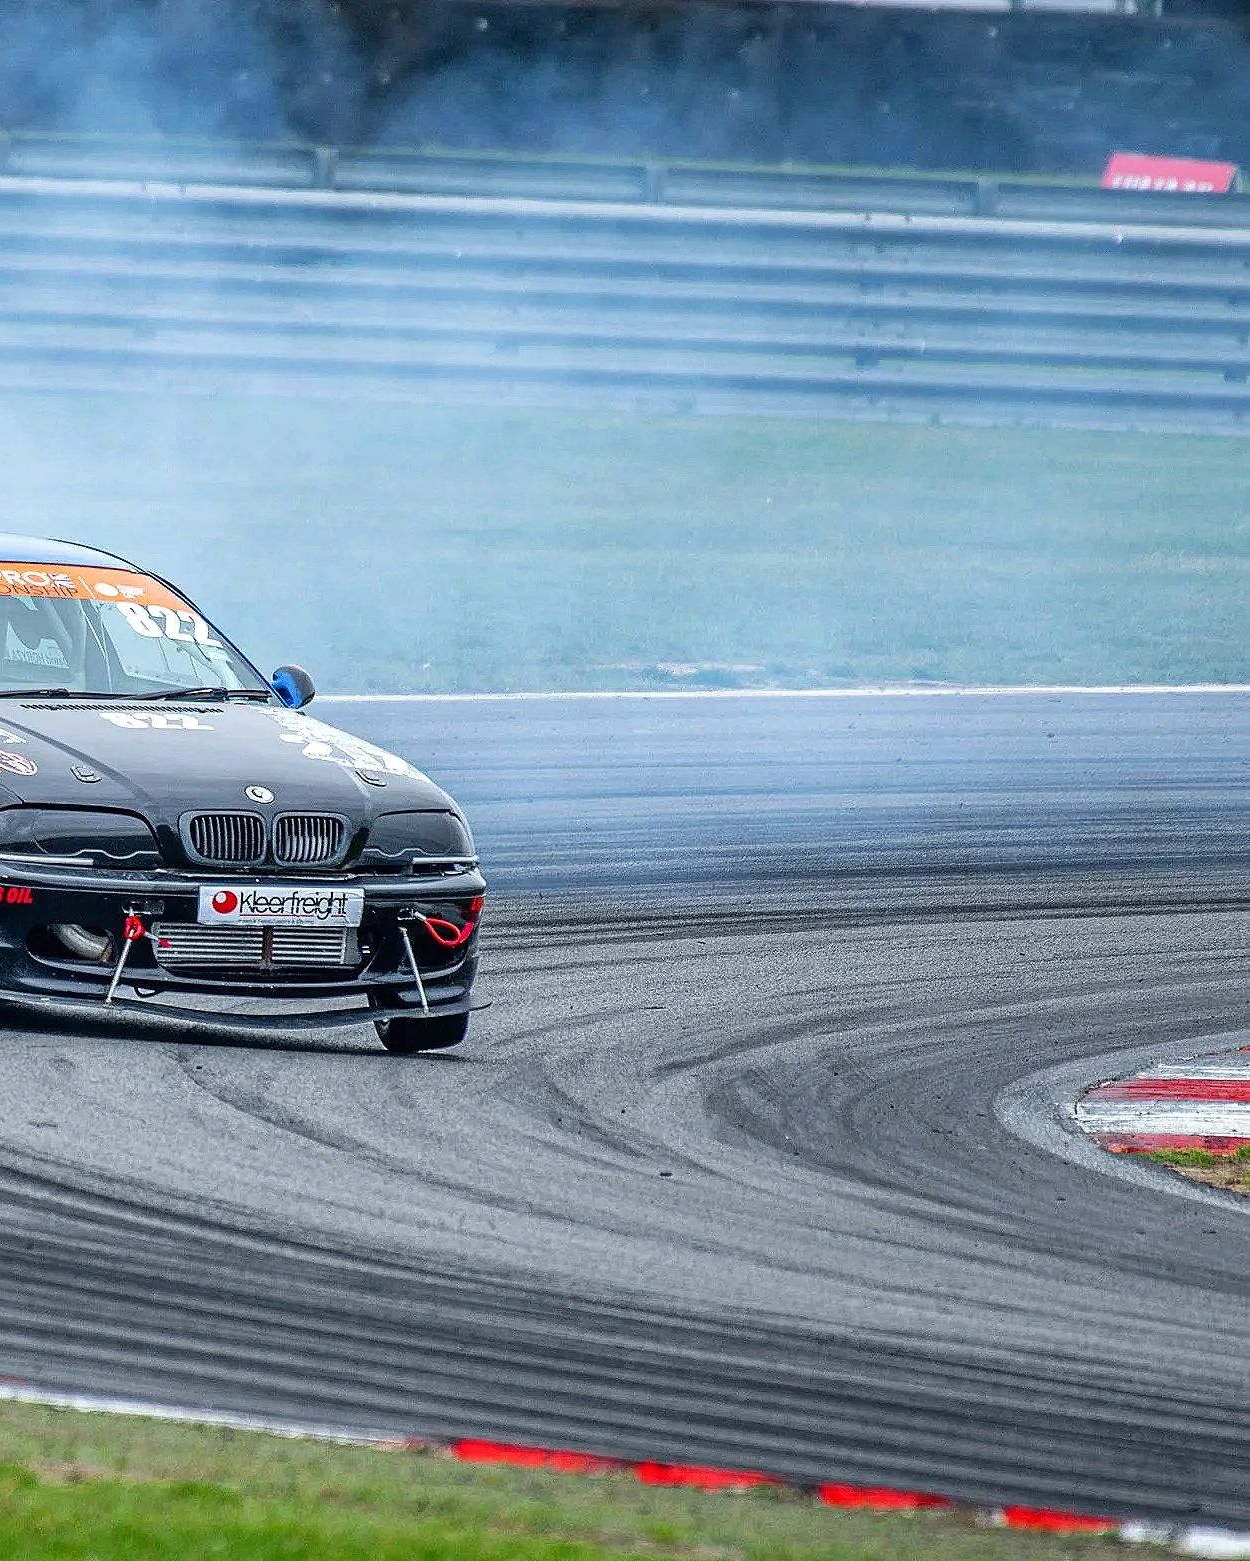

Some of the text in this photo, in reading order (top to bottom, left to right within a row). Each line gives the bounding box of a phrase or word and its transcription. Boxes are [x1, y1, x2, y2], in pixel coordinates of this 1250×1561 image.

[116, 601, 224, 648] 822
[99, 711, 215, 731] 822
[7, 887, 33, 904] OIL
[239, 890, 348, 920] Kleerfreight
